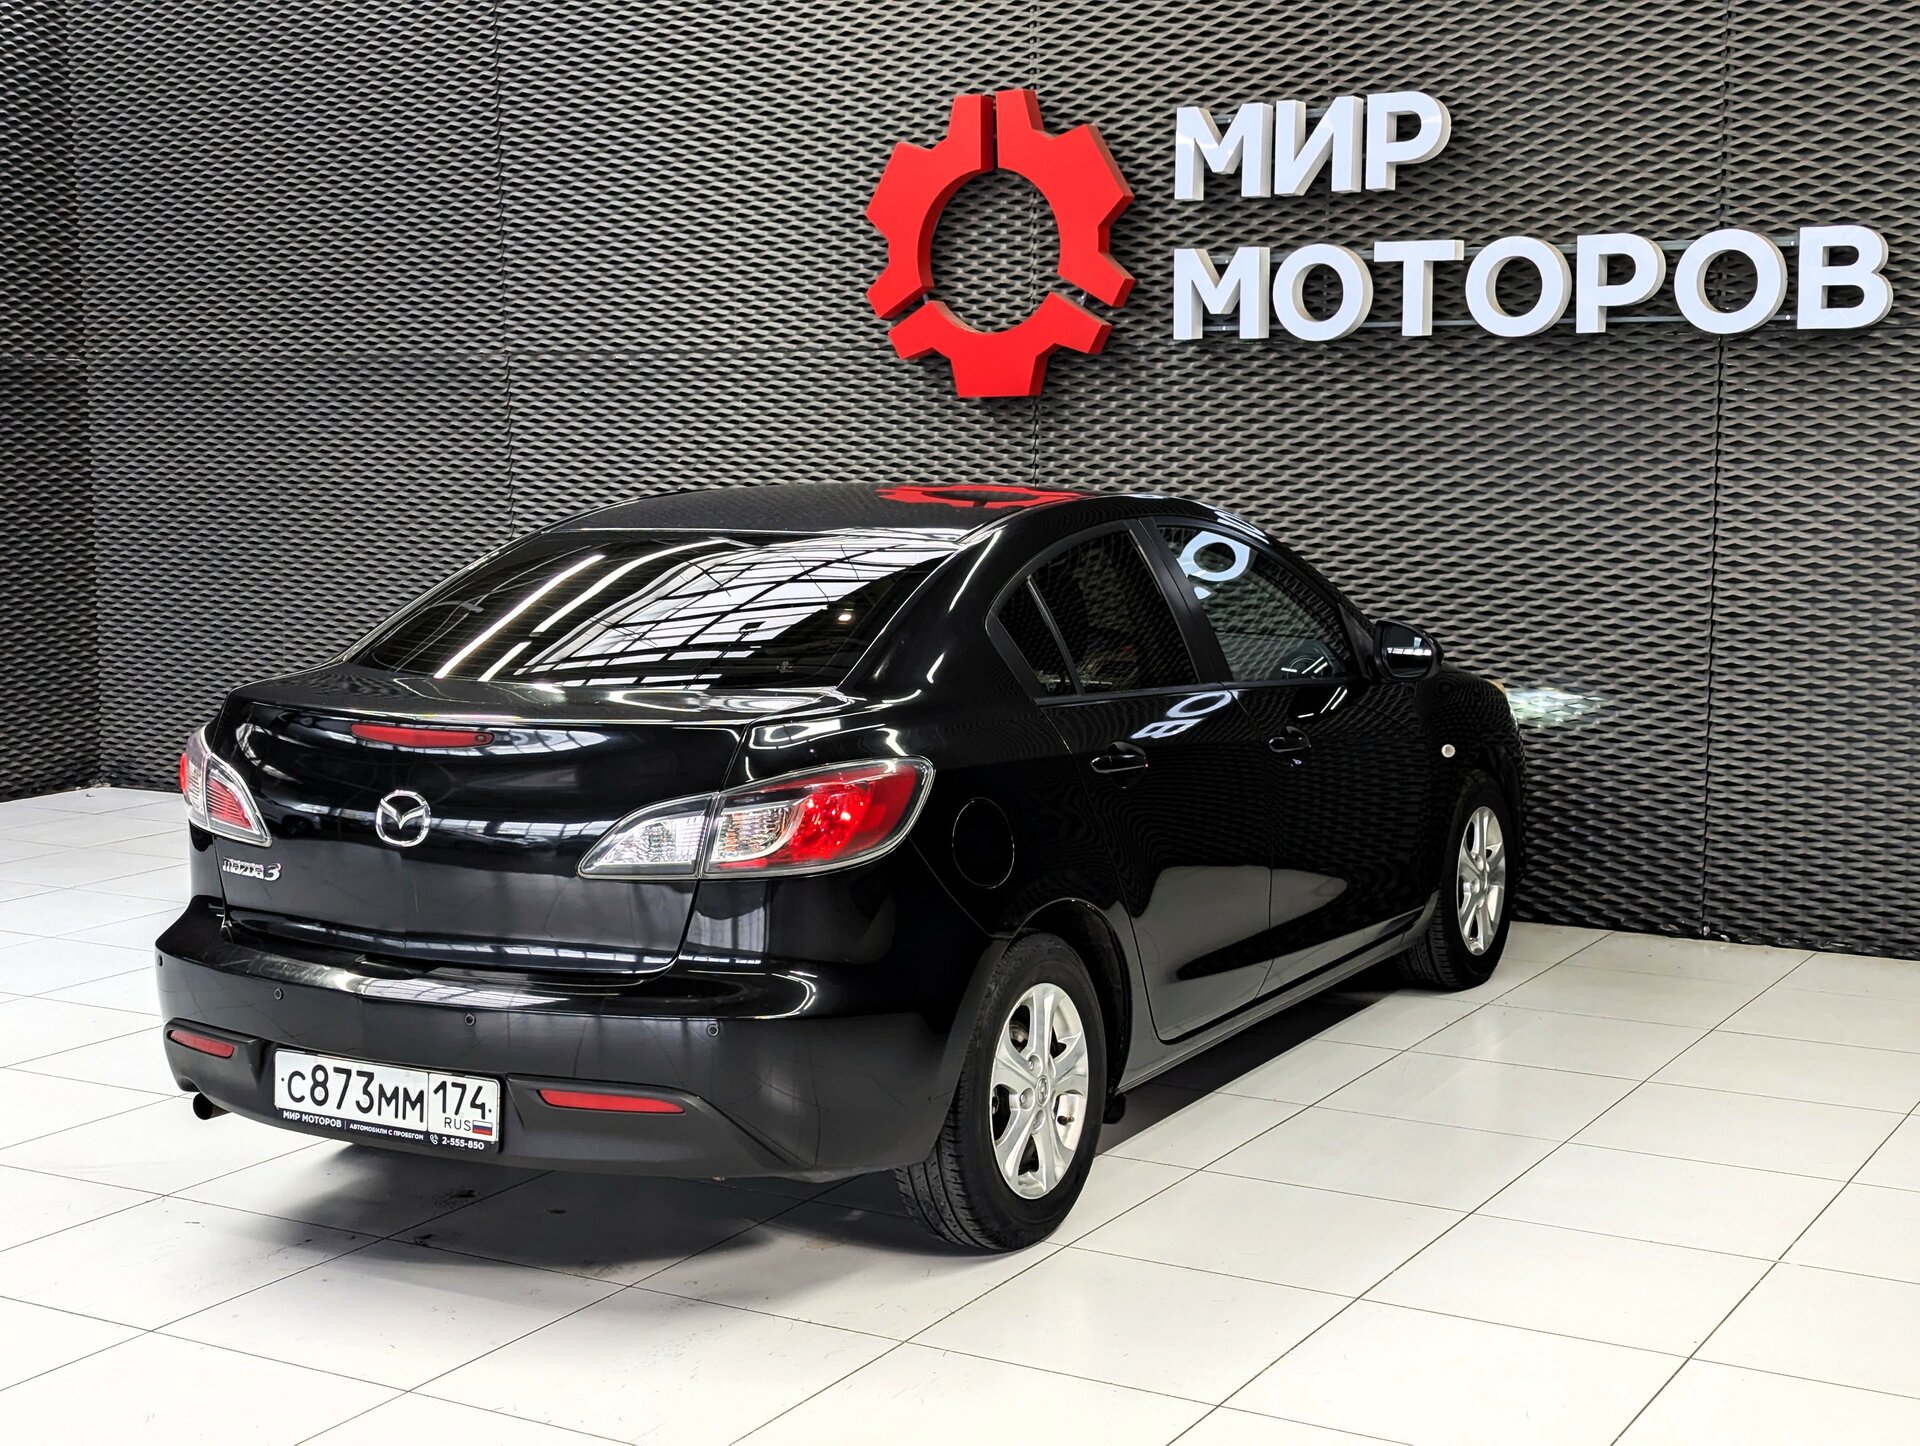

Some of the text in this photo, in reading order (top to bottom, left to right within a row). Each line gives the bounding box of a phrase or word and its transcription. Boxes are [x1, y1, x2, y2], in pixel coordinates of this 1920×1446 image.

[1174, 90, 1451, 200] МИР
[1173, 224, 1894, 341] МОТОРОВ
[433, 1080, 486, 1120] 174
[283, 1111, 342, 1128] МИР МОТОРОВ
[444, 1117, 471, 1132] RUS
[349, 1124, 424, 1140] АВТОМОБИЛИ С ПРОБЕГОМ
[442, 1137, 484, 1149] 2-555-850
